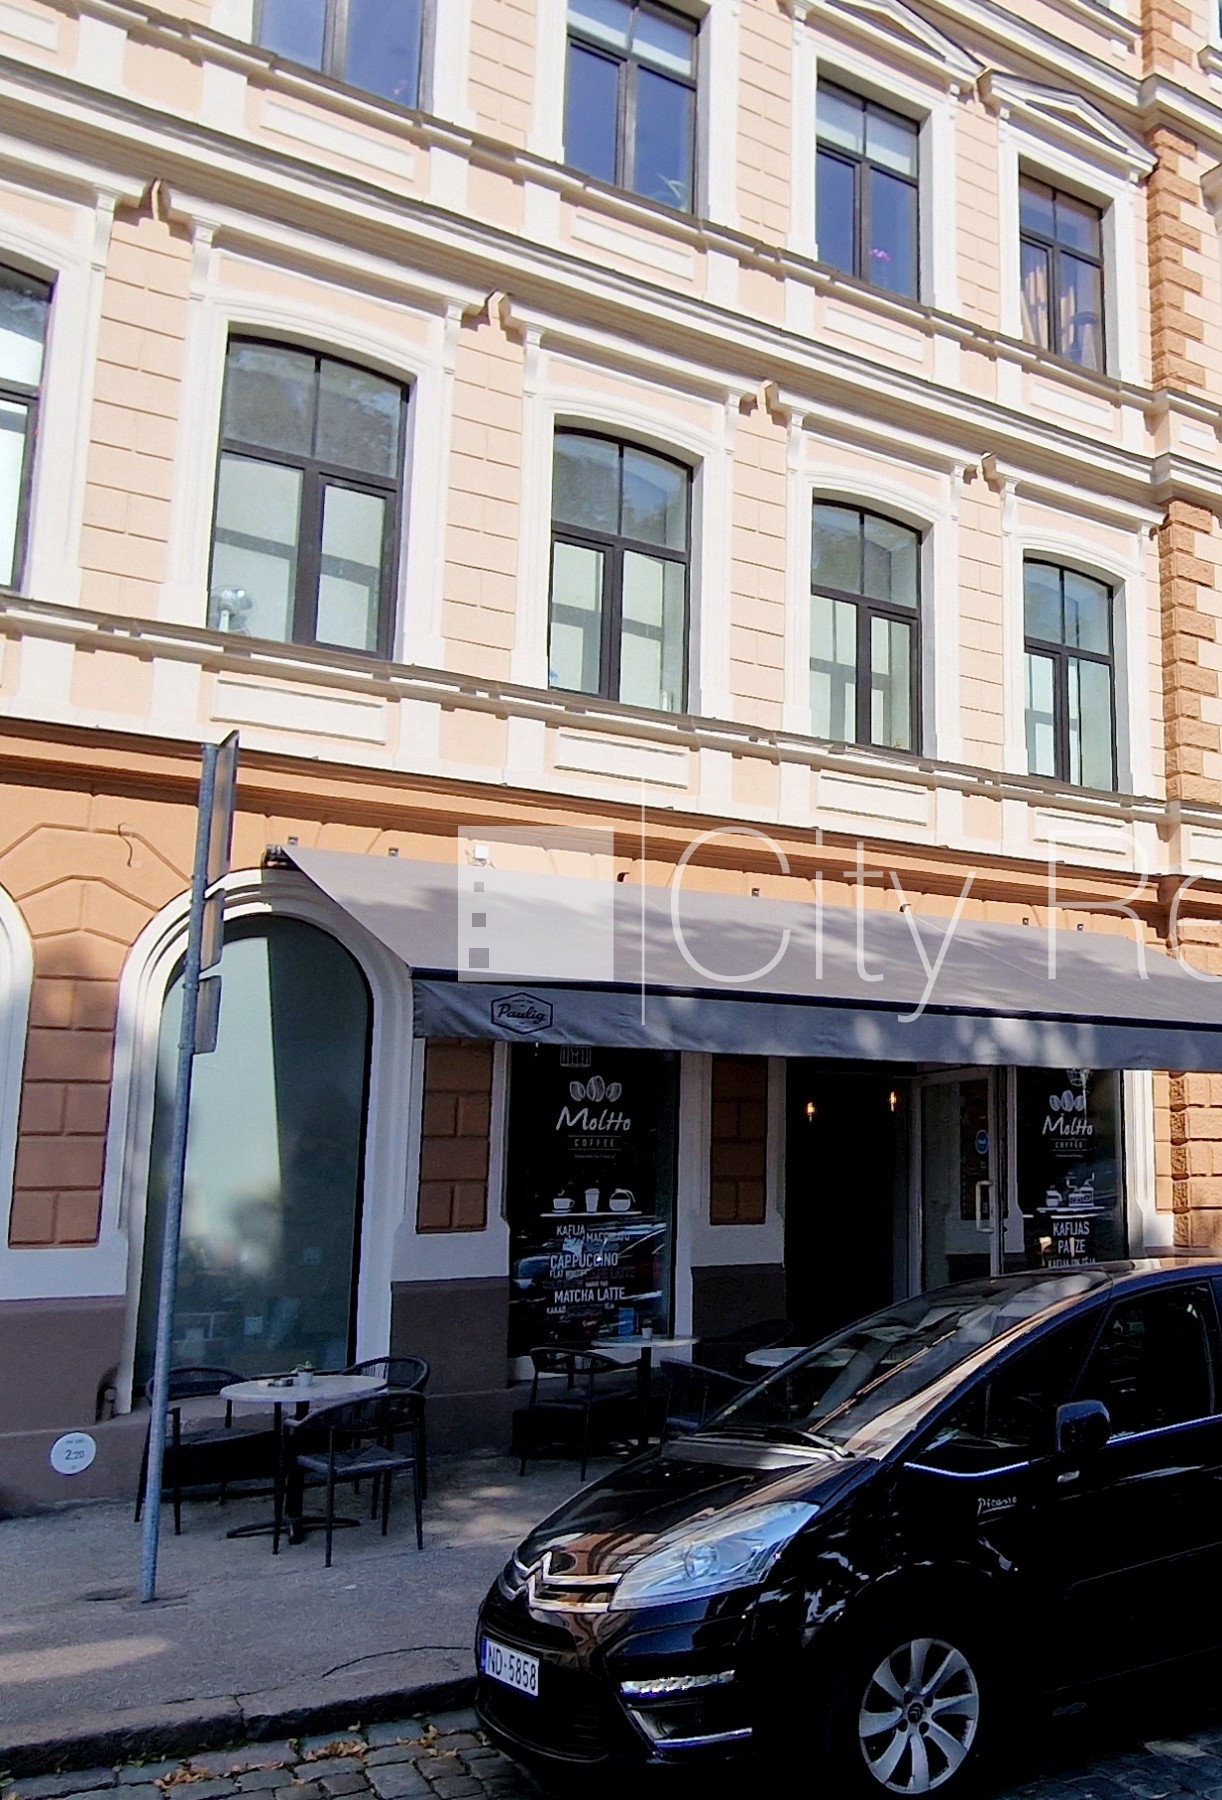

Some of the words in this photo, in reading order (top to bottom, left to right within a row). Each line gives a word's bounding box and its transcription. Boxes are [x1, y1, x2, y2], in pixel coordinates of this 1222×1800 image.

[497, 1003, 547, 1025] Paulig
[574, 1138, 616, 1147] COFFEE
[1057, 1238, 1086, 1254] PAZE
[550, 1252, 619, 1270] CAPPUCCINO
[554, 1288, 595, 1304] MATCHA
[597, 1286, 626, 1301] LATTE
[487, 1644, 537, 1691] ND-5858
